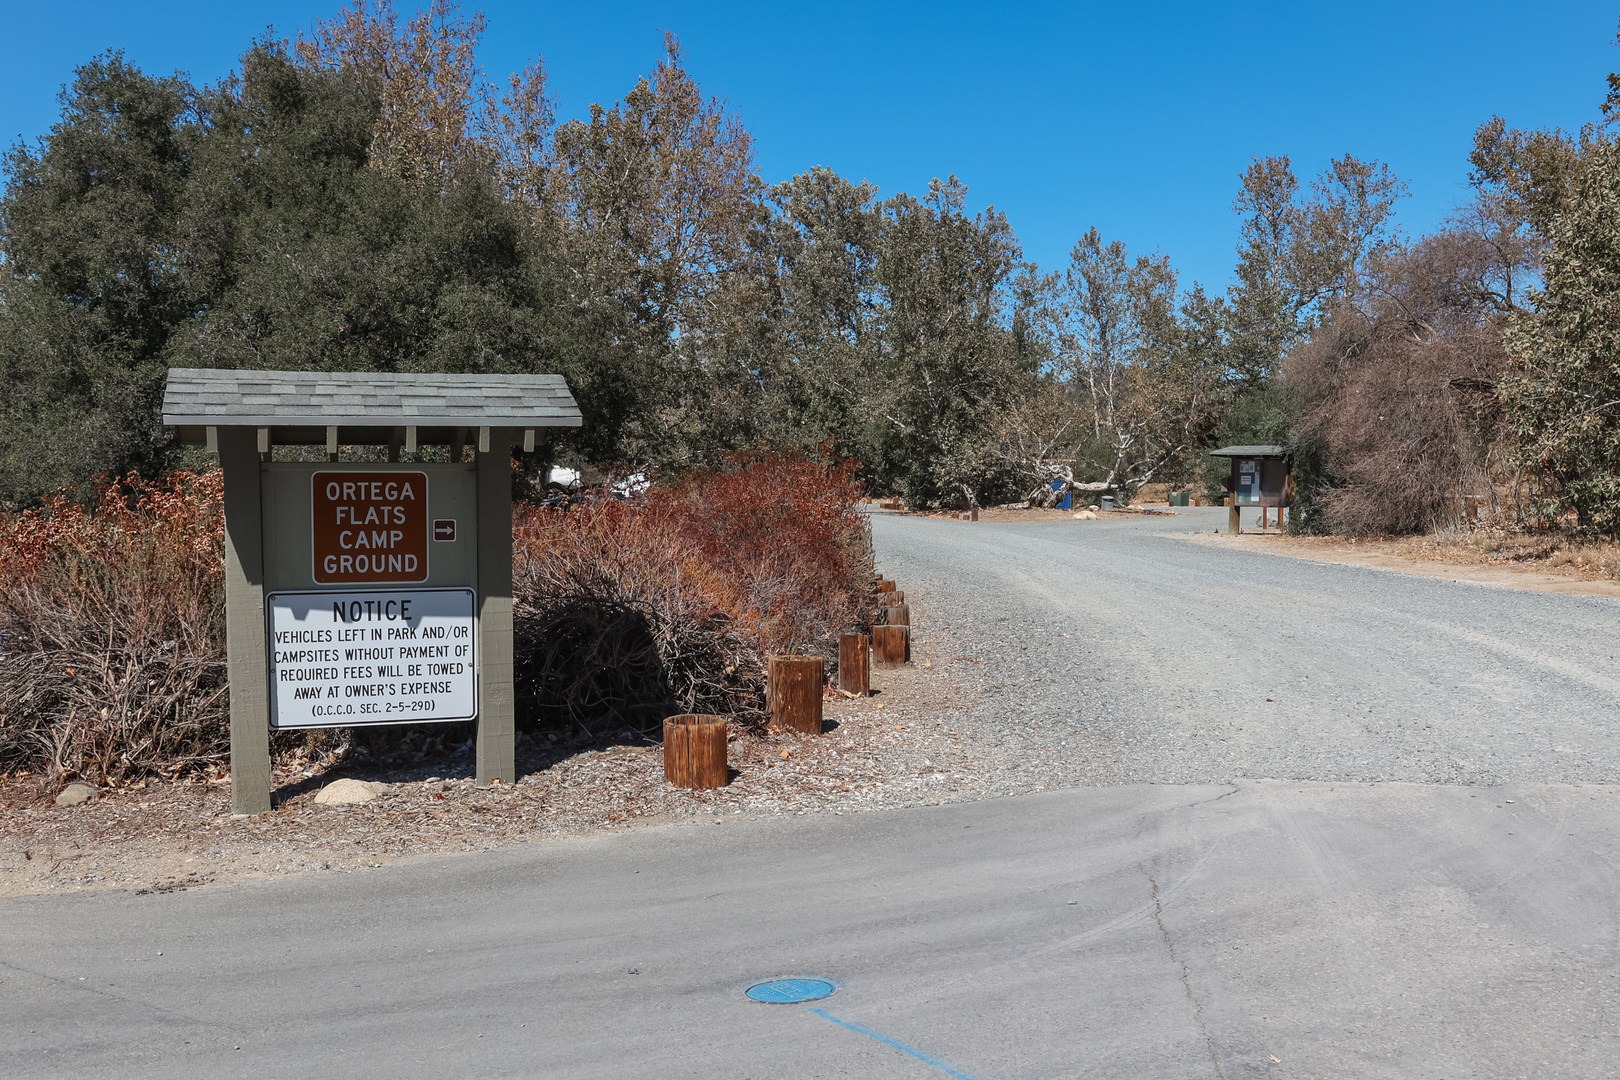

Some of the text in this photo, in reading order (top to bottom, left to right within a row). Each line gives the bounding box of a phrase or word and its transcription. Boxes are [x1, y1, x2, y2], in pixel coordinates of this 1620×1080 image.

[326, 482, 415, 501] ORTEGA
[336, 506, 406, 525] FLATS
[339, 530, 403, 549] CAMP
[323, 554, 418, 574] GROUND
[333, 599, 413, 622] NOTICE
[275, 625, 468, 643] VEHICLES LEFT IN PARK AND/OR
[274, 645, 469, 664] CAMPSITES WITHOUT PAYMENT OF
[280, 662, 463, 681] REQUIRED FEES WILL BE TOWED
[294, 687, 322, 699] AWAY
[327, 686, 340, 698] AT
[401, 681, 452, 695] EXPENSE
[360, 703, 381, 714] SEC.
